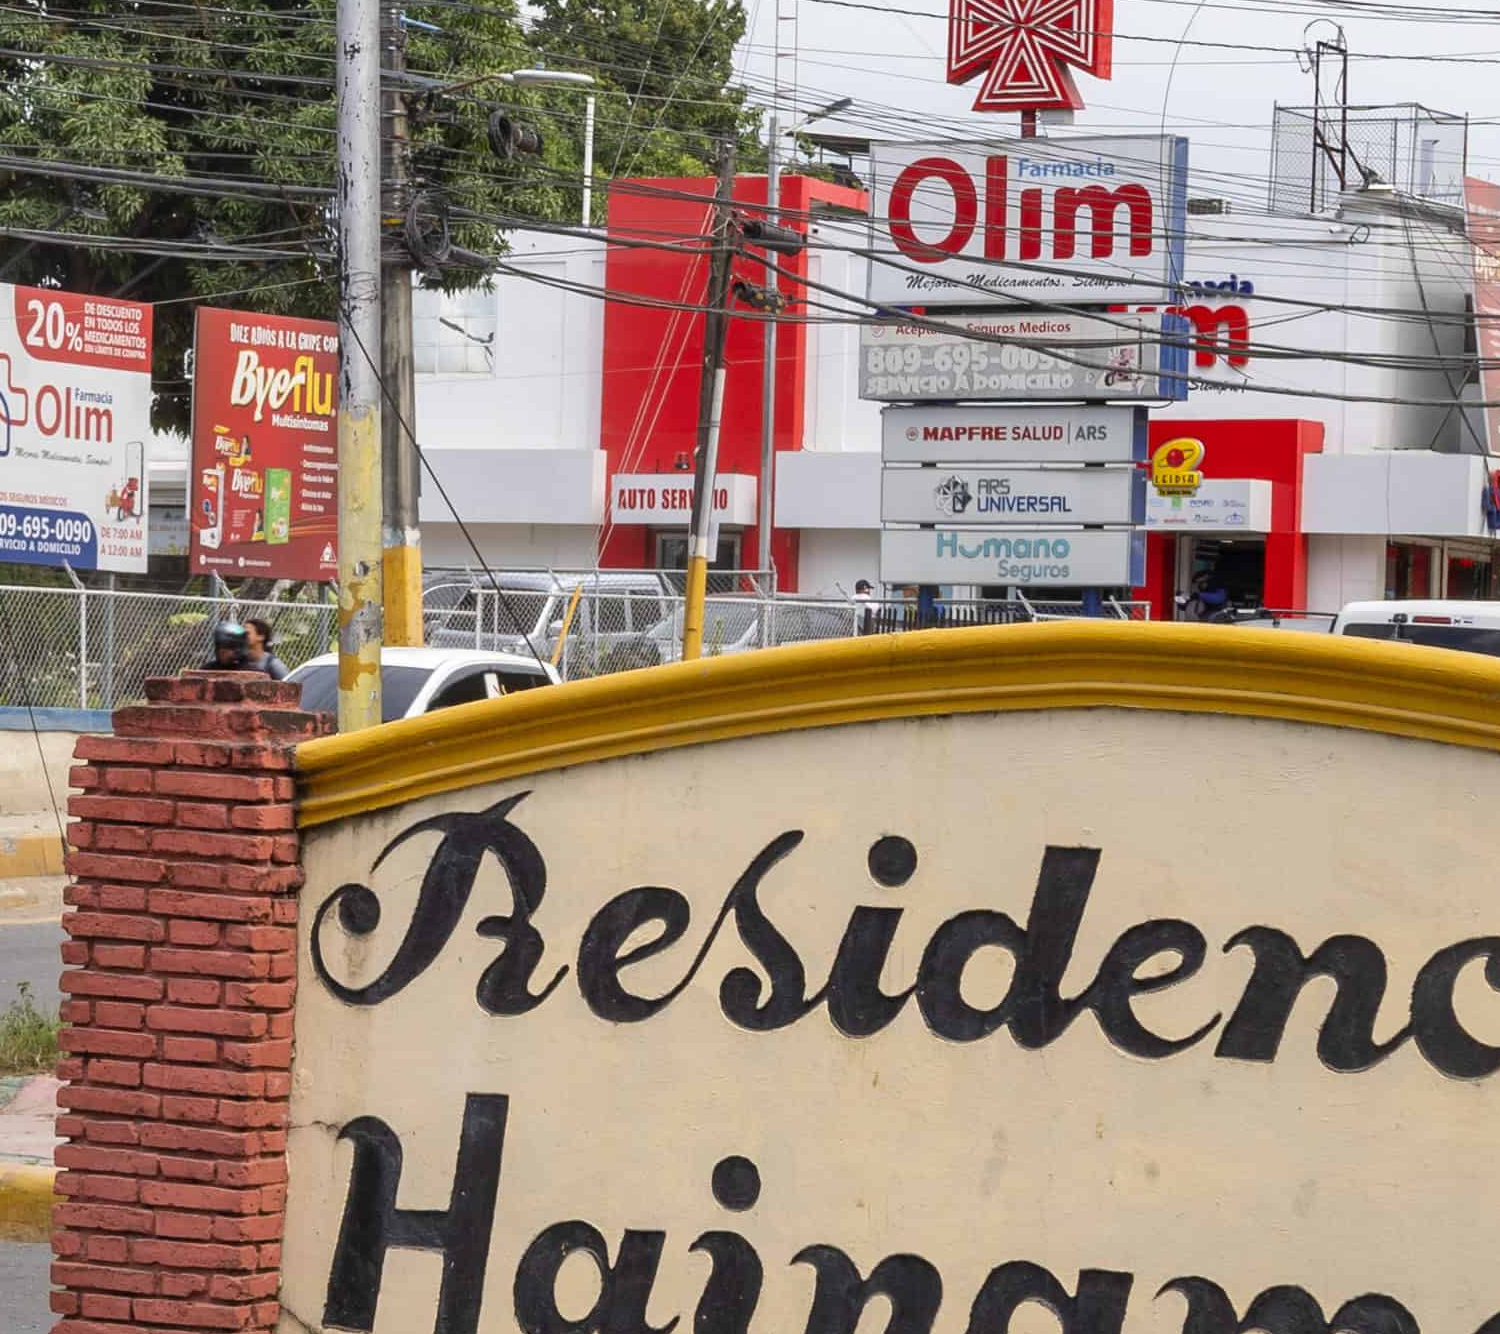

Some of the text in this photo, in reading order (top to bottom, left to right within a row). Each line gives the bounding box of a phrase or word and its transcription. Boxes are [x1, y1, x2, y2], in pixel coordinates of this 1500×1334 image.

[1017, 157, 1115, 178] Farmacia
[887, 154, 1153, 264] Olim
[84, 301, 143, 321] DE DESCUENTO
[26, 299, 83, 353] 20%
[84, 316, 140, 335] EN TODOS LOS
[1019, 321, 1072, 334] Medicos
[84, 329, 147, 349] MEDICAMENTOS
[278, 330, 285, 348] A
[285, 330, 297, 349] LA
[298, 332, 322, 352] GRIPE
[74, 388, 113, 405] Farmacia
[35, 384, 113, 444] Olim
[923, 424, 1108, 441] MAPFRE SALUD ARS
[977, 478, 1011, 495] ARS
[618, 488, 728, 510] AUTO SERVIO
[977, 495, 1072, 513] UNIVERSAL
[28, 540, 35, 552] A
[37, 540, 81, 556] DOMICILIO
[936, 532, 1071, 559] Humano
[997, 560, 1070, 582] Seguros
